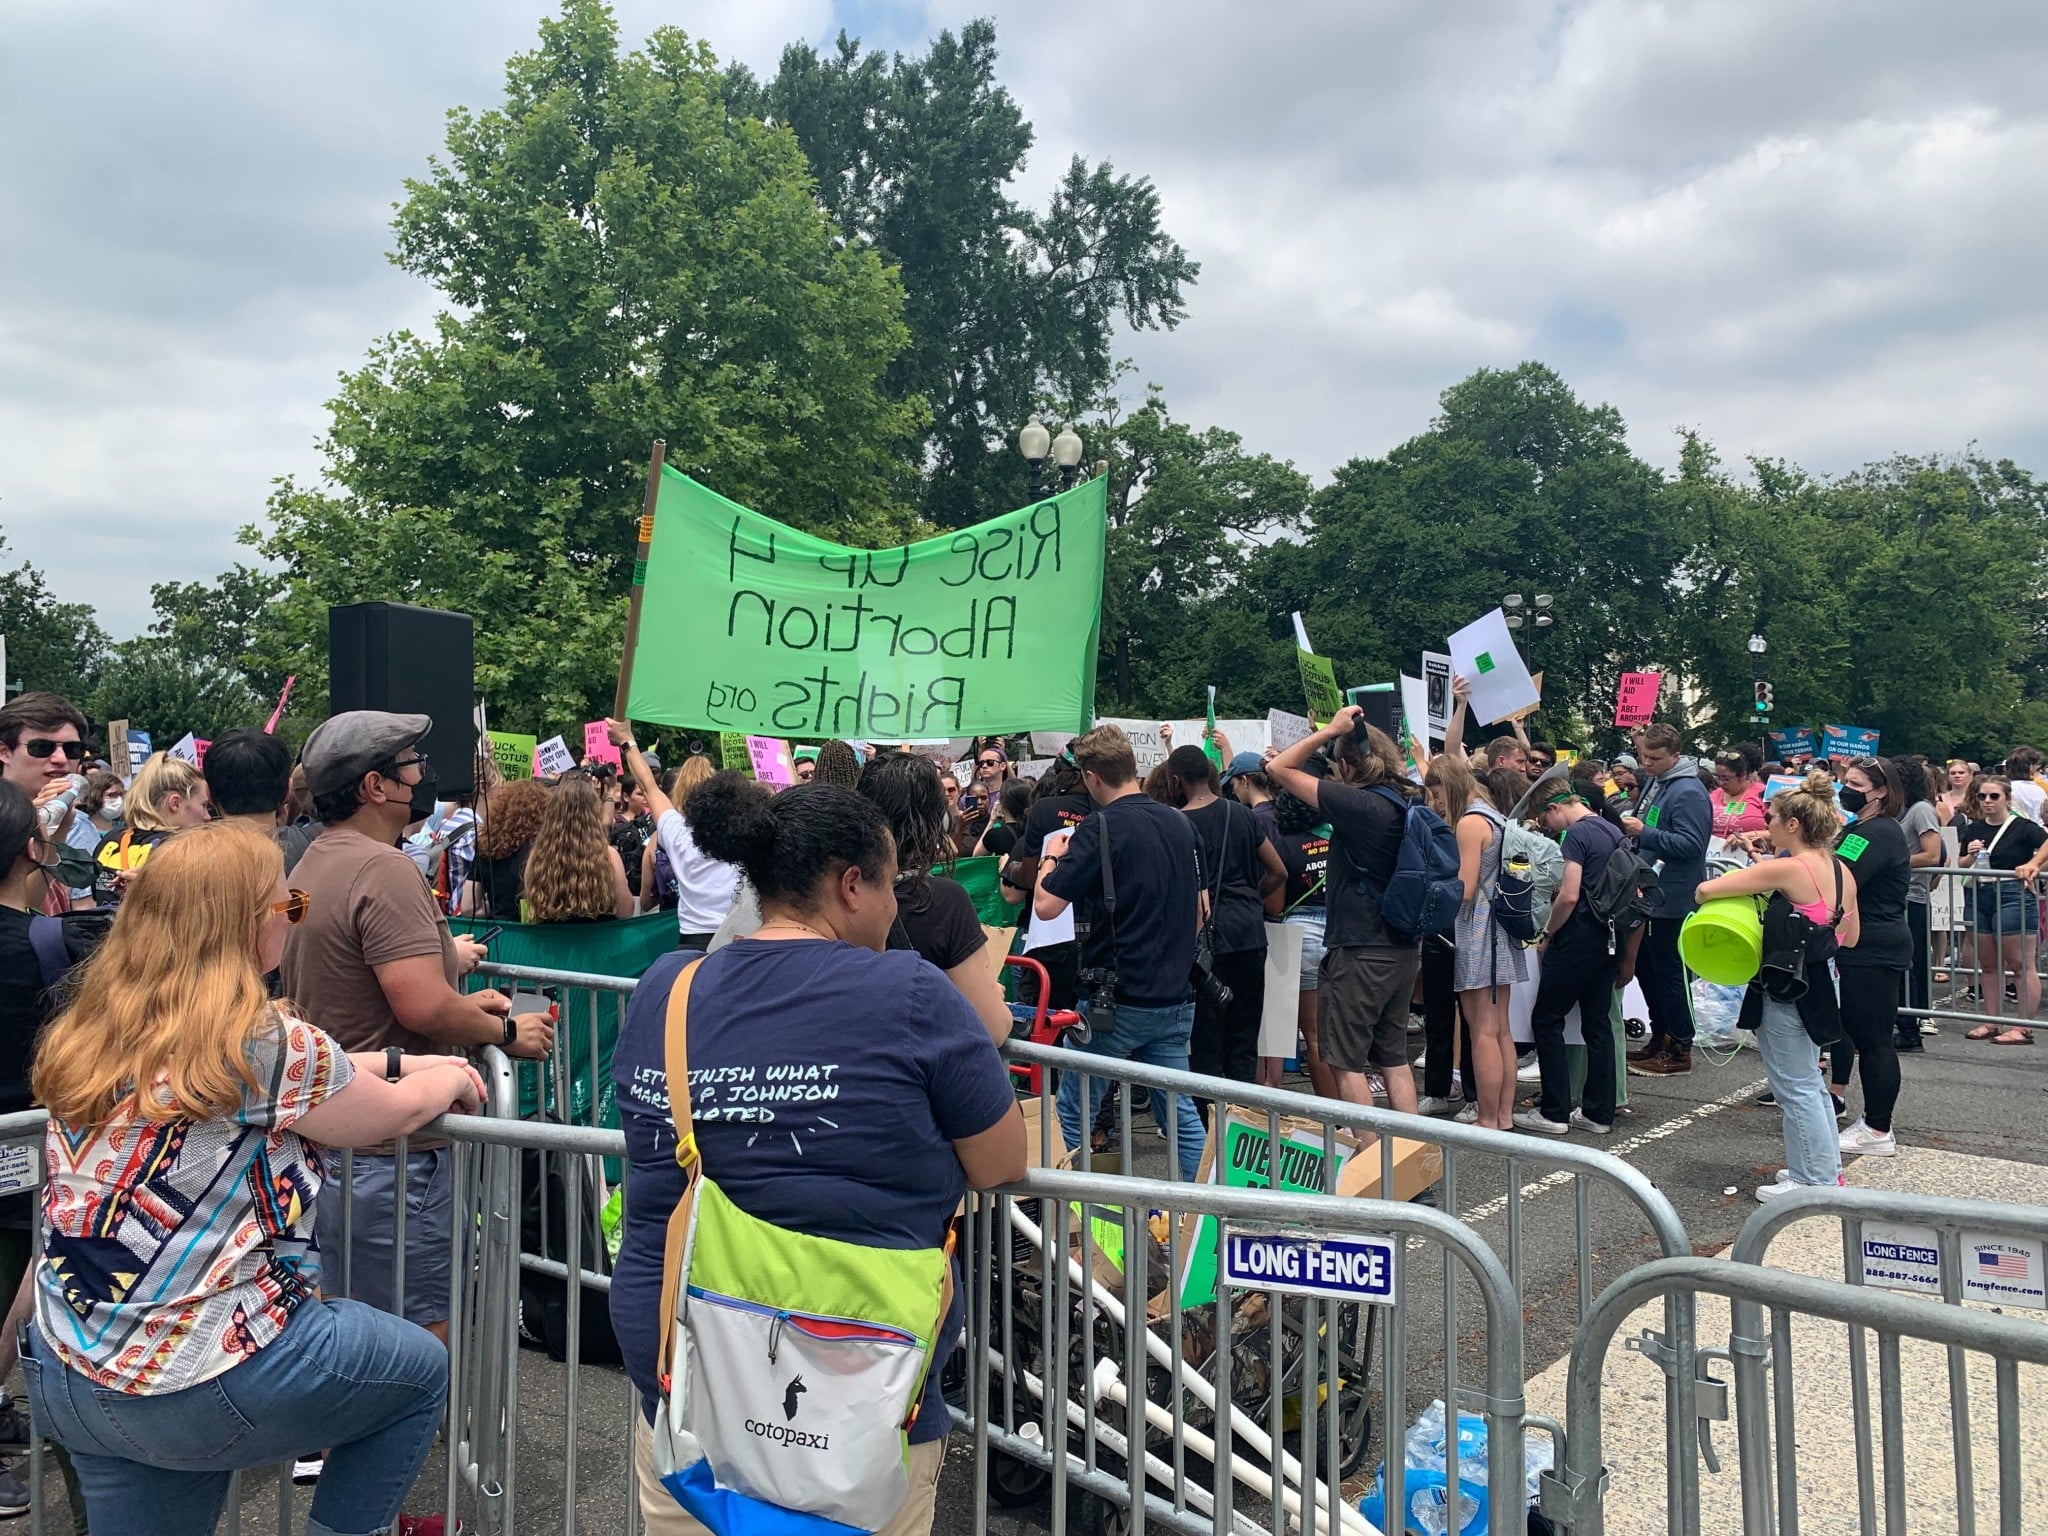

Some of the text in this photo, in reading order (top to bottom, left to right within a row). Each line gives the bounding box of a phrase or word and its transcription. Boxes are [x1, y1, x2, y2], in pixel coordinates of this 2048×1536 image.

[1629, 677, 1645, 685] WILL
[1624, 686, 1636, 694] AID
[1621, 705, 1638, 713] ABET
[591, 726, 602, 734] WILL
[495, 742, 517, 752] UCK
[723, 738, 747, 746] SCOTU
[753, 740, 768, 749] WILL
[1792, 740, 1810, 748] HANDS
[493, 752, 528, 763] COTUS
[543, 748, 566, 765] AID AND
[753, 750, 763, 758] AID
[756, 760, 762, 768] &
[758, 771, 774, 780] ABET
[765, 1064, 839, 1081] WHAT
[700, 1087, 718, 1103] P.
[727, 1084, 840, 1102] JOHNSON
[1866, 1242, 1936, 1263] LONG FENCE
[1974, 1244, 2032, 1258] SINCE 1945
[1234, 1236, 1385, 1288] LONG FENCE
[1865, 1268, 1939, 1285] 888-887-5664
[1967, 1279, 2044, 1297] longfence.com
[744, 1418, 830, 1450] cotopaxi
